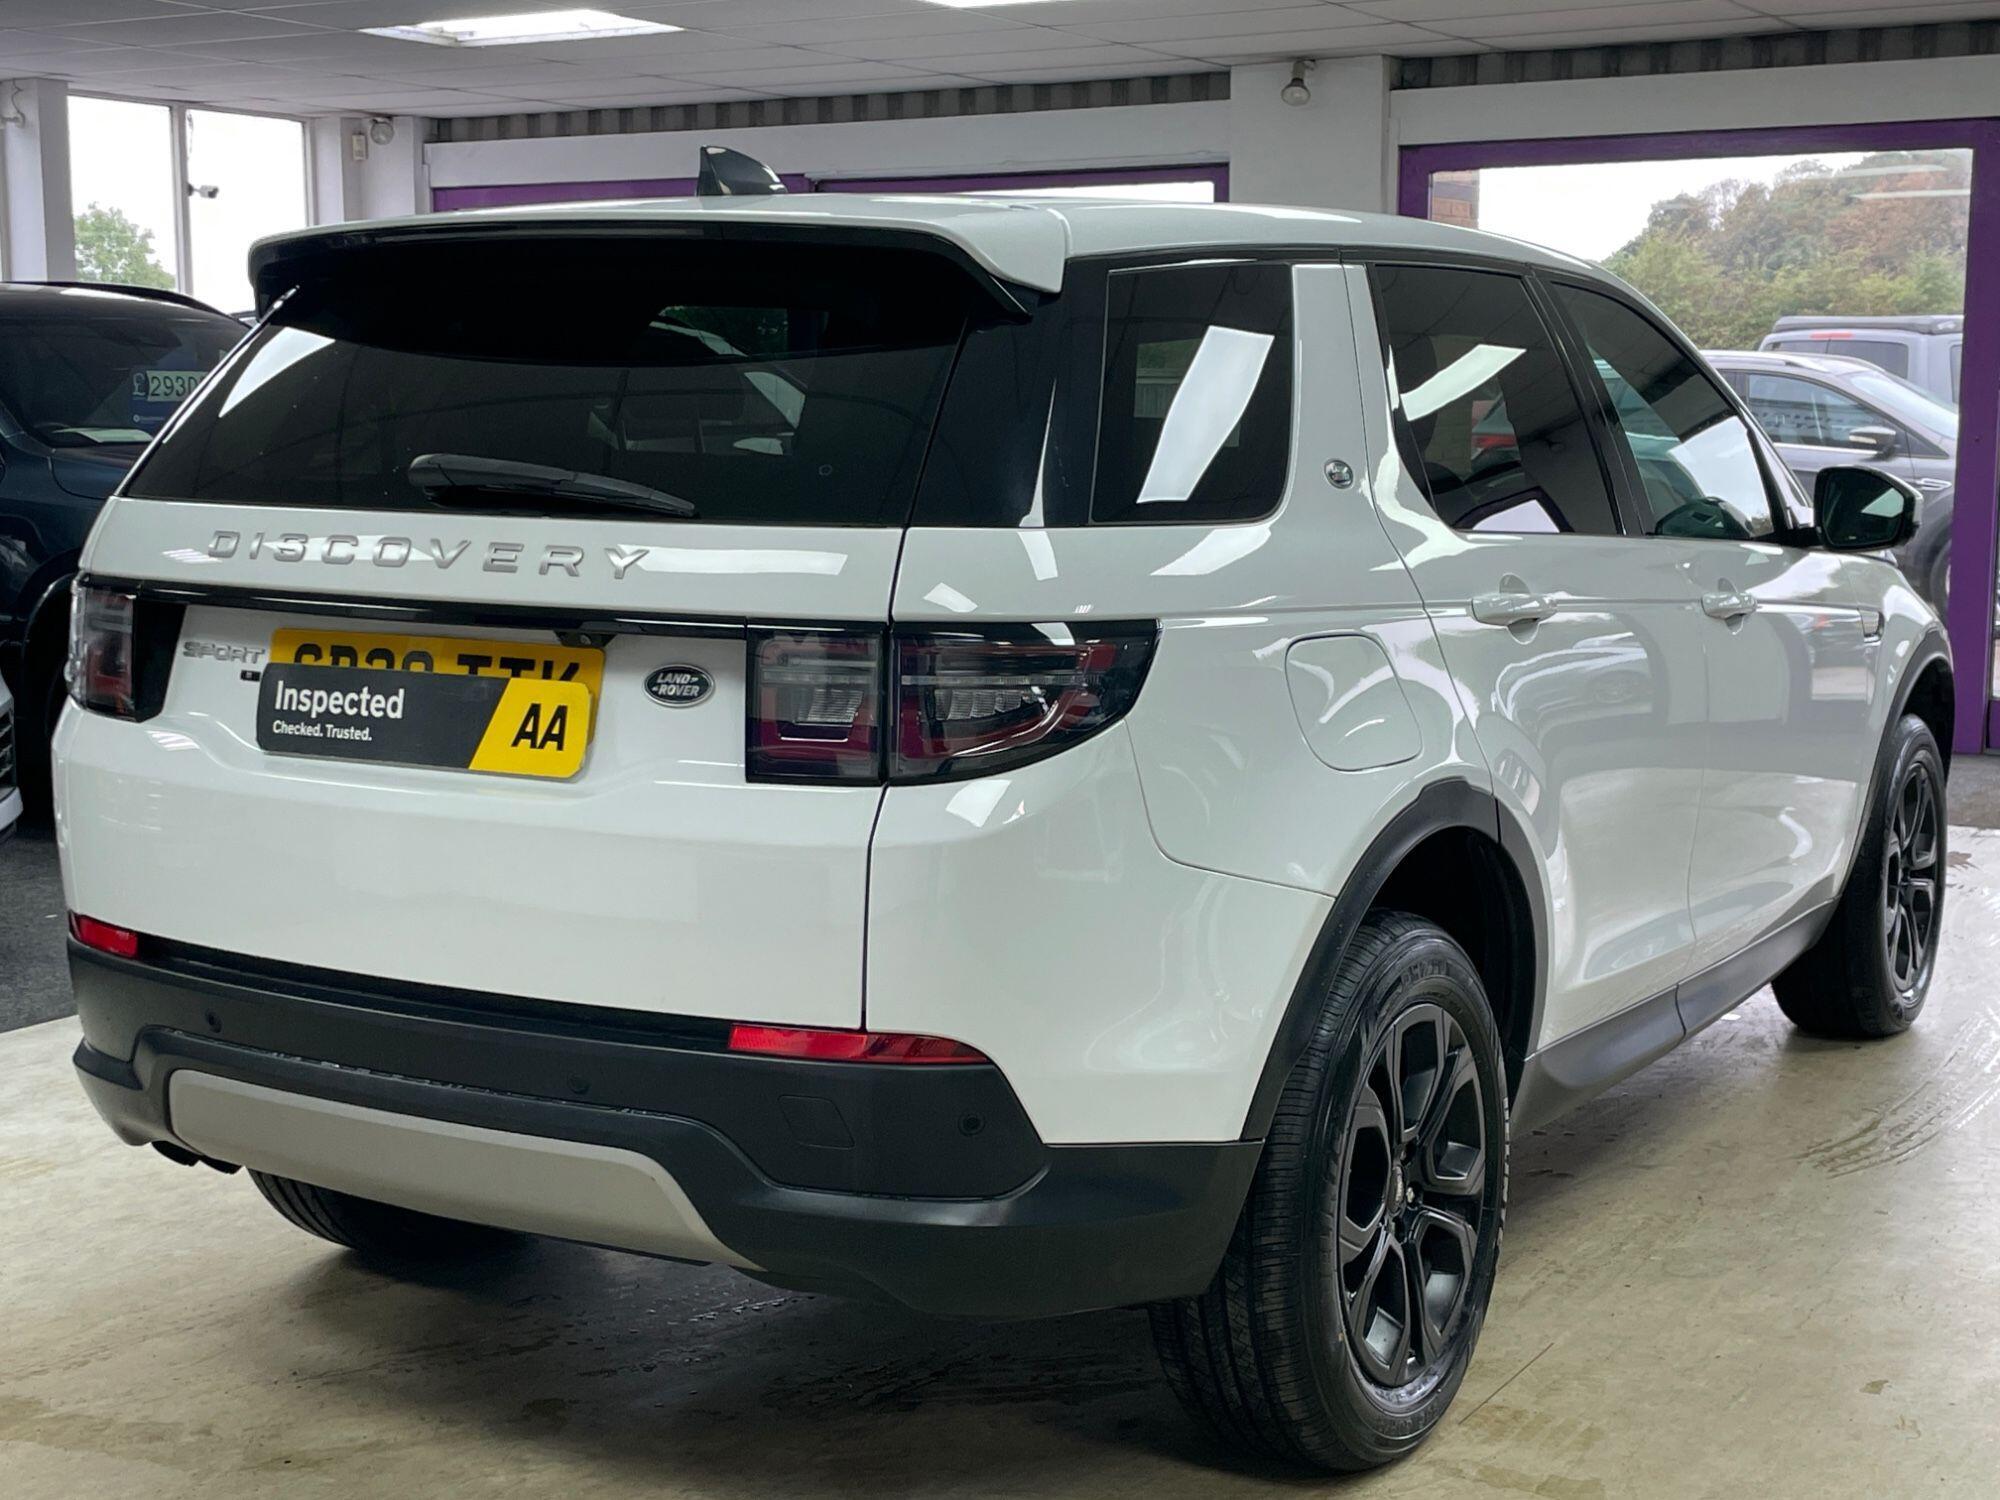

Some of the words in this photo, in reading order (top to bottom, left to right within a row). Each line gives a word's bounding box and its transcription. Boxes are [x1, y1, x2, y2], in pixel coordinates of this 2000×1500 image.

[207, 529, 650, 580] DISCOVERY
[183, 641, 266, 664] SPORT
[656, 672, 691, 684] LAND
[274, 680, 405, 719] Inspected
[657, 683, 700, 697] ROVER
[272, 719, 323, 738] Checked.
[325, 723, 373, 742] Trusted.
[510, 702, 568, 752] AA
